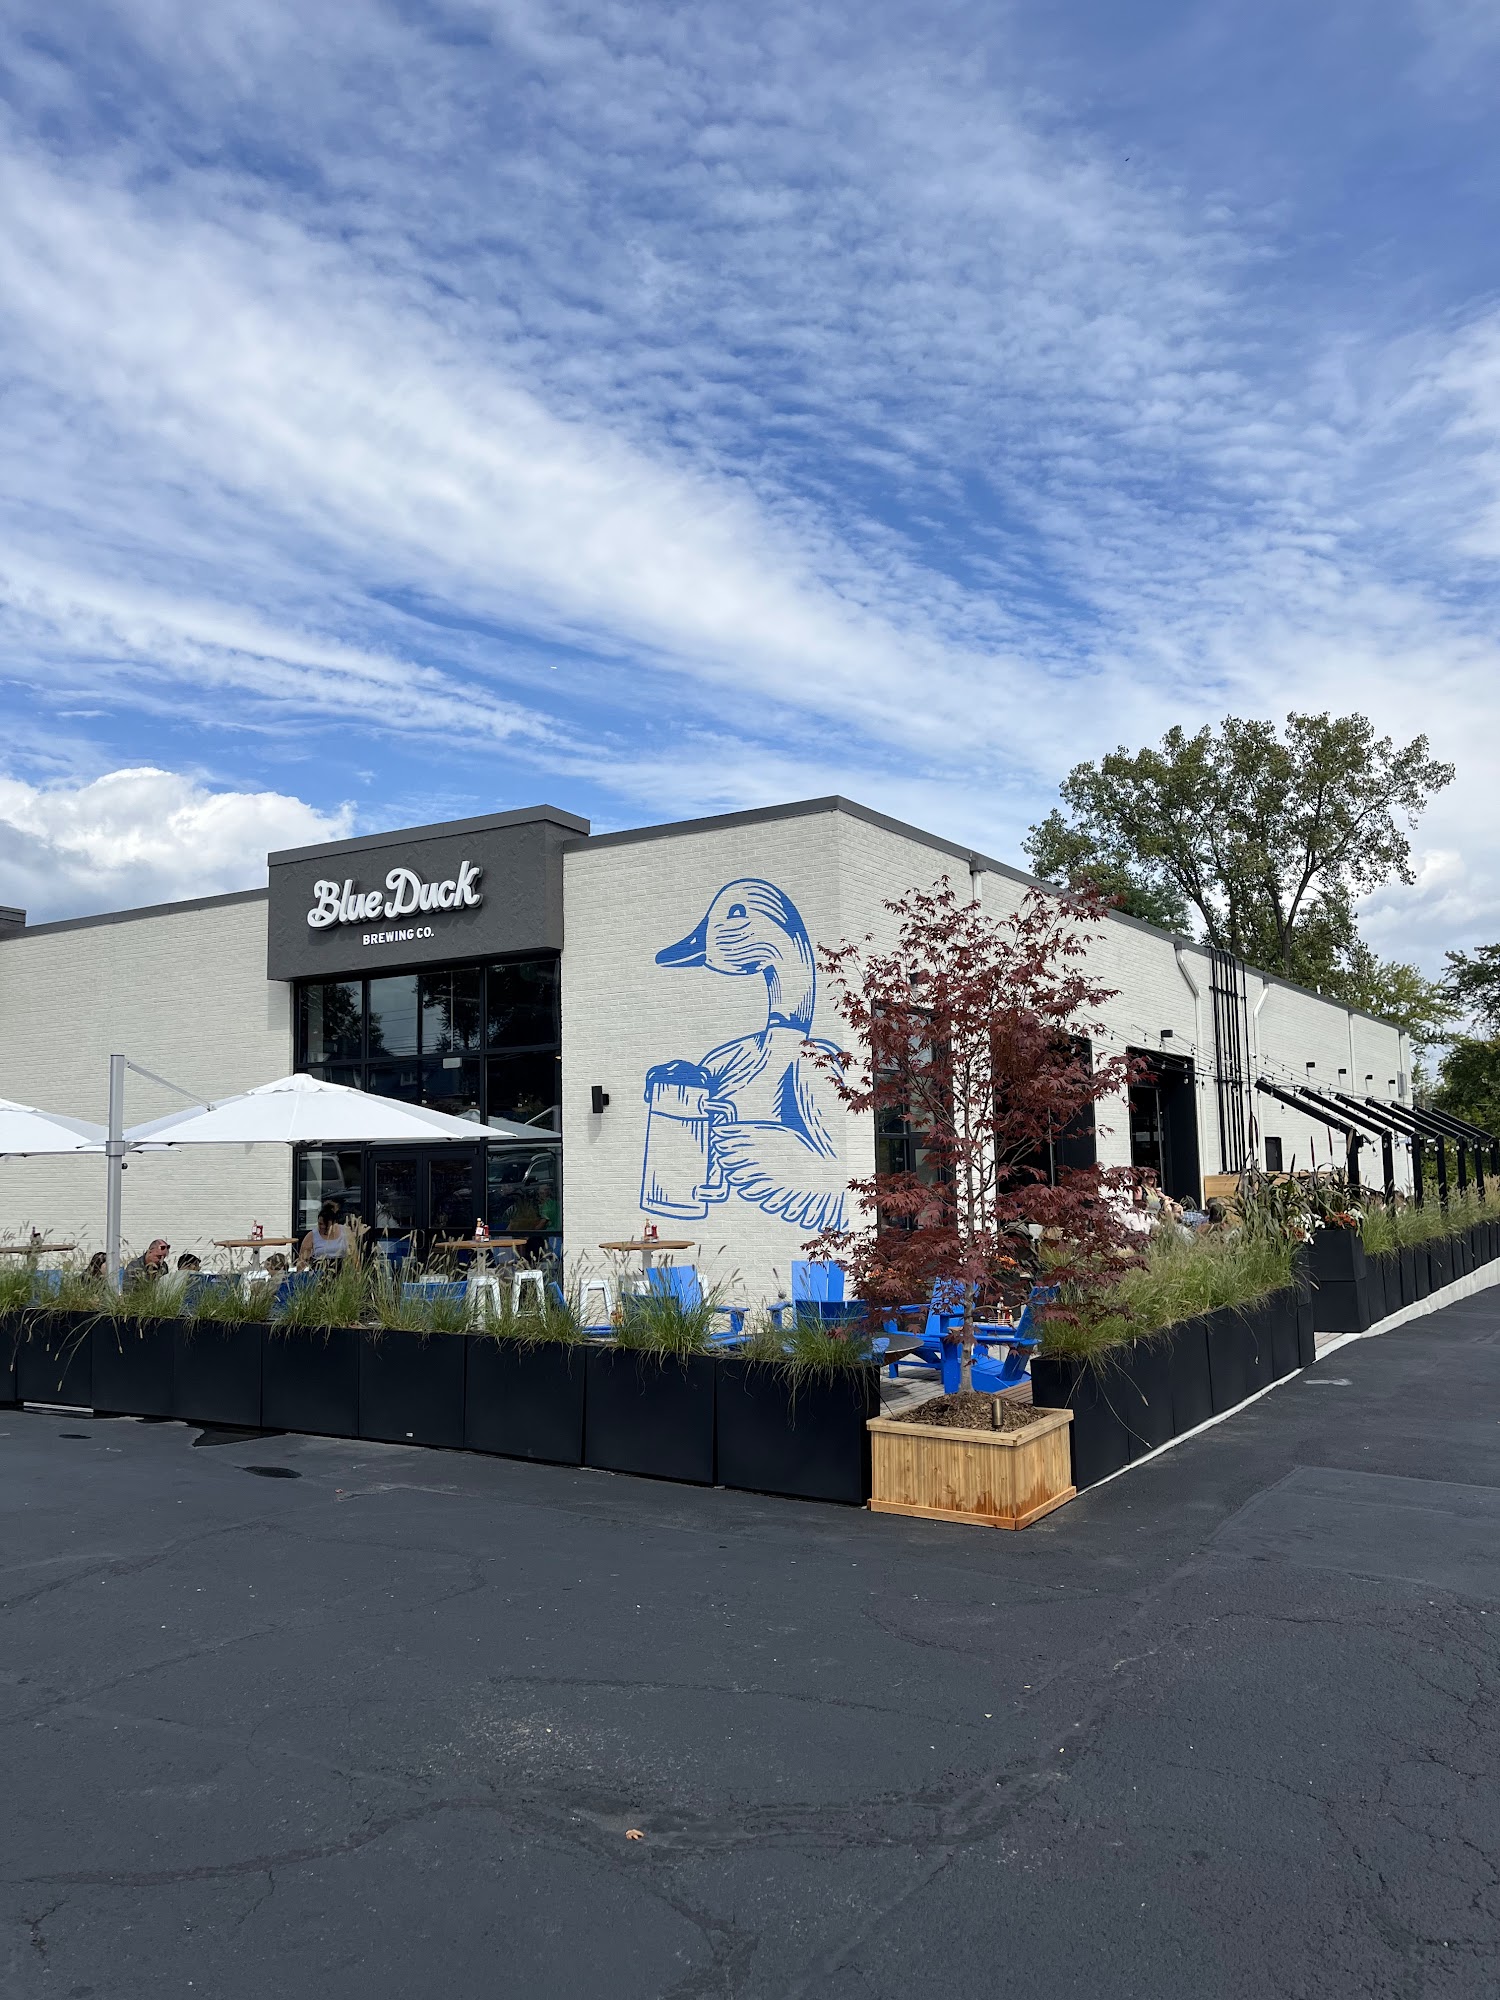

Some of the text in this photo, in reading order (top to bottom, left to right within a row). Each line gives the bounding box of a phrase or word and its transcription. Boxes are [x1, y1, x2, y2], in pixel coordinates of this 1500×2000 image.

[307, 860, 481, 928] Blue Duck
[362, 926, 435, 946] BREWING CO.
